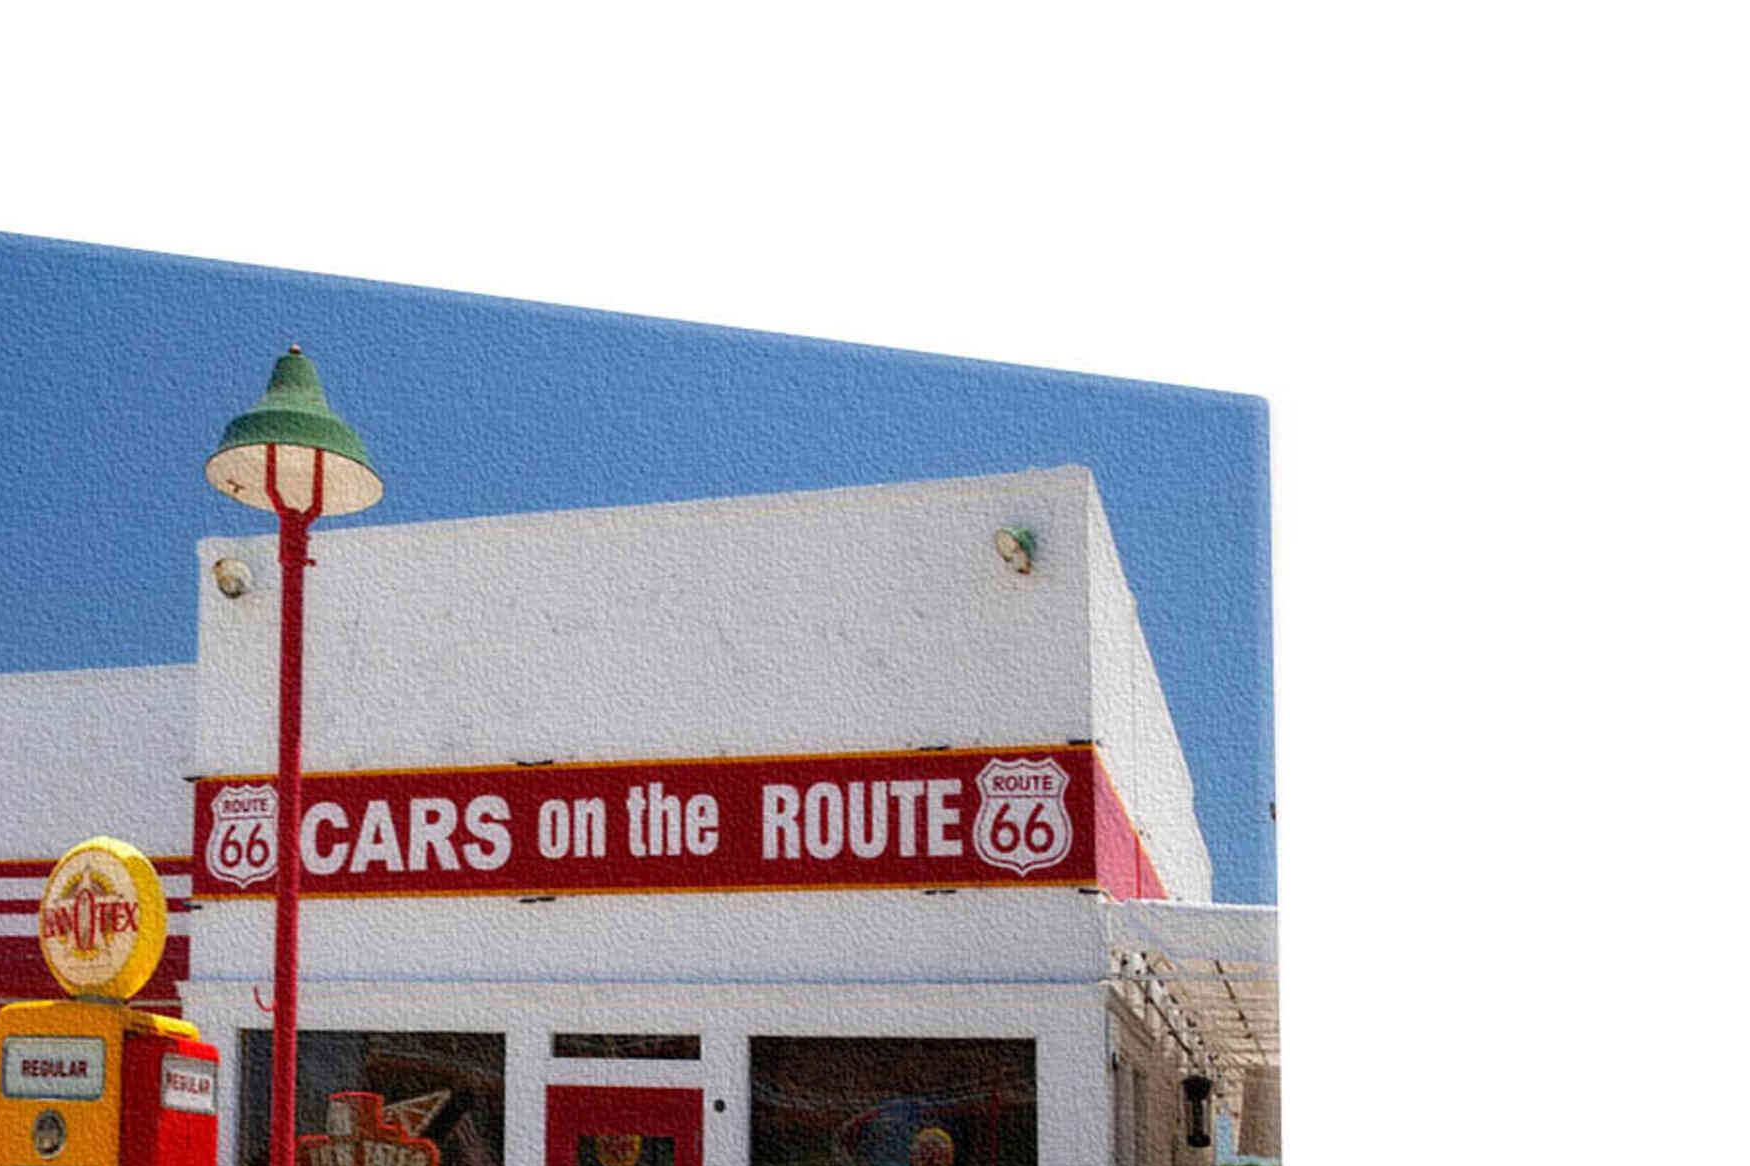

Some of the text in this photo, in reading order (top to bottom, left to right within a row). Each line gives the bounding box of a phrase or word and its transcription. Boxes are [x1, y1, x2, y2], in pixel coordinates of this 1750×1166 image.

[993, 775, 1053, 791] ROUTE
[223, 798, 268, 813] ROUTE
[300, 778, 963, 875] CARS on the ROUTE
[991, 803, 1054, 853] 66
[220, 824, 269, 868] 66
[21, 1059, 88, 1078] REGULAR
[166, 1071, 211, 1095] REGULAR
